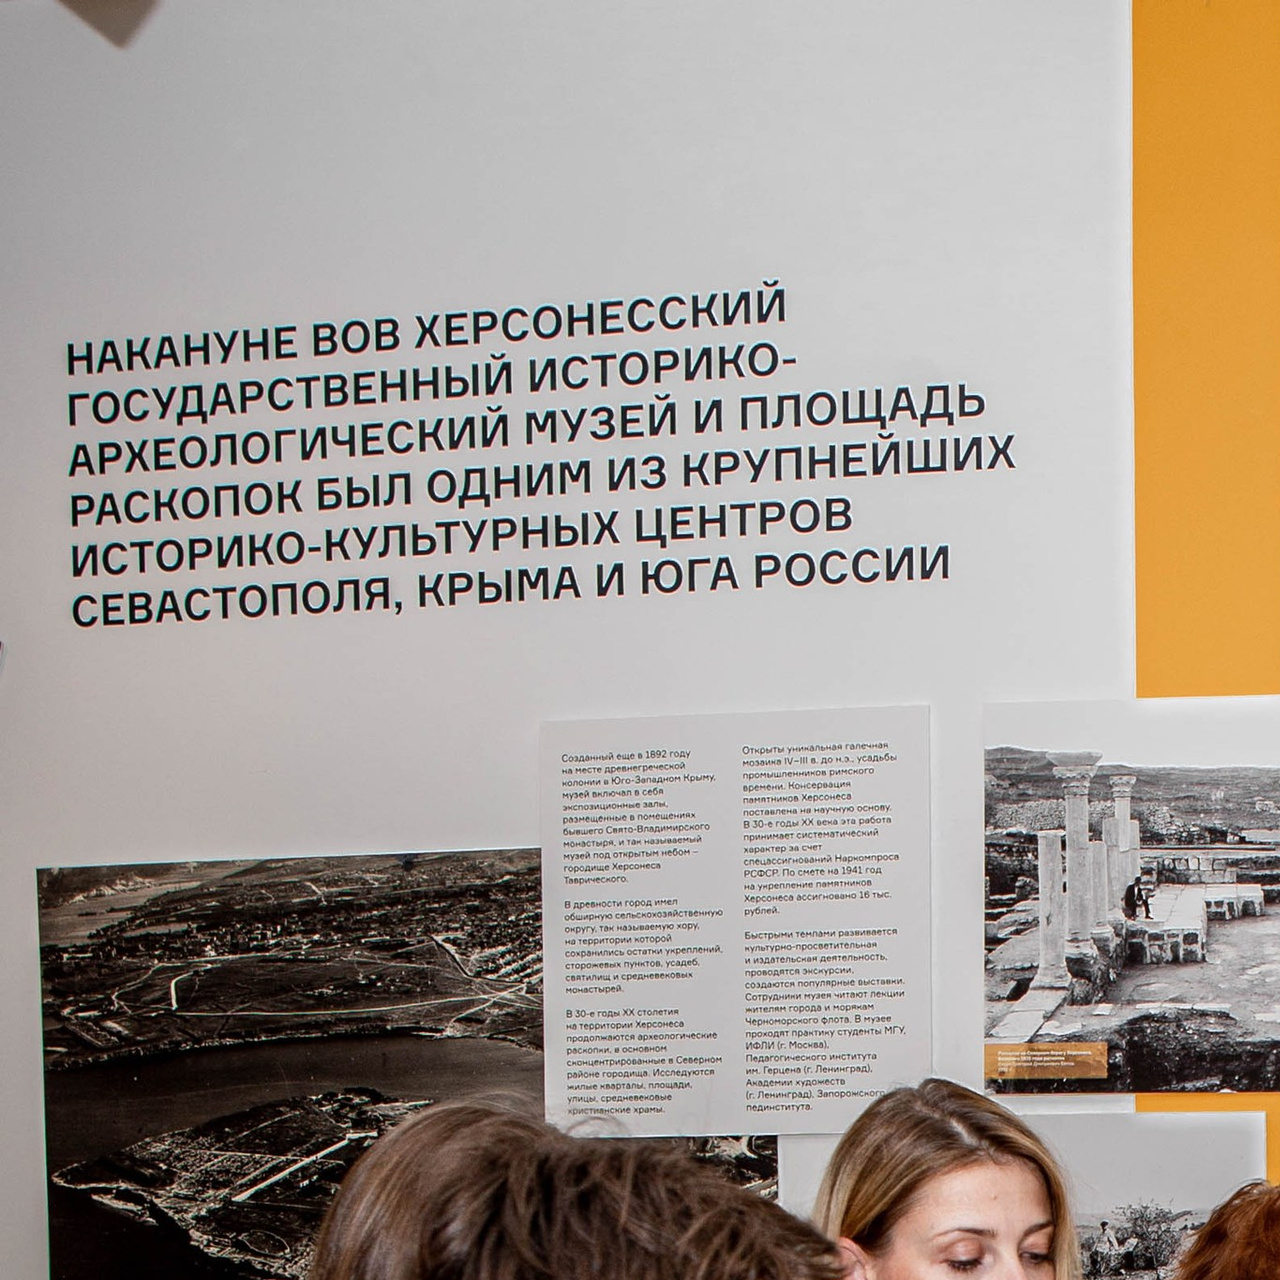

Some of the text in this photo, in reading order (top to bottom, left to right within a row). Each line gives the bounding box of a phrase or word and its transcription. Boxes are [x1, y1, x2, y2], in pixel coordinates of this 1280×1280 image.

[68, 281, 784, 375] НАКАНУНЕ ВОВ ХЕРСОНЕССКИЙ
[69, 346, 796, 426] ГОСУДАРСТВЕННЫЙ ИСТОРИКО-
[69, 385, 984, 477] АРХЕОЛОГИЧЕСКИЙ МУЗЕЙ И ПЛОЩАДЬ
[72, 435, 1015, 526] РАСКОПОК БЫЛ ОДНИМ ИЗ КРУПНЕЙШИХ
[72, 498, 851, 576] ИСТОРИКО-КУЛЬТУРНЫХ ЦЕНТРОВ
[73, 546, 948, 627] СЕВАСТОПОЛЯ, КРЫМА И ЮГА РОССИИ
[561, 751, 614, 765] Созданный
[616, 752, 635, 762] еще
[645, 749, 667, 759] 1892
[669, 750, 691, 760] году
[575, 766, 602, 774] месте
[604, 760, 686, 775] древнегреческой
[742, 767, 875, 782] промышленников римского
[562, 778, 601, 786] колонии
[603, 777, 609, 785] в
[611, 773, 681, 787] Юго-Западном
[788, 778, 851, 792] Консервация
[562, 785, 664, 801] музей включал в себя
[743, 790, 852, 804] памятников Херсонеса
[563, 801, 641, 814] экспозиционные
[562, 814, 627, 826] размещенные
[637, 811, 696, 823] помещениях
[562, 821, 711, 836] бывшего Свято-Владимирского
[743, 826, 879, 843] принимает систематический
[627, 838, 642, 846] так
[644, 834, 702, 845] называемый
[563, 846, 691, 862] музей под открытым небом
[743, 851, 900, 868] спецассигнований Наркомпроса
[563, 860, 661, 875] городище Херсонеса
[564, 899, 571, 908] В
[573, 899, 623, 910] древности
[624, 898, 653, 909] город
[744, 892, 794, 905] Херсонеса
[796, 892, 857, 901] ассигновано
[859, 889, 870, 899] 16
[564, 907, 724, 924] обширную сельскохозяйственную
[616, 923, 675, 934] называемую
[744, 928, 898, 942] Быстрыми темпами развивается
[578, 936, 632, 947] территории
[634, 933, 672, 946] которой
[564, 949, 625, 960] сохранились
[626, 947, 663, 956] остатки
[565, 961, 621, 972] сторожевых
[565, 973, 611, 984] святилищ
[621, 971, 693, 982] средневековых
[744, 990, 905, 1004] Сотрудники музея читают лекции
